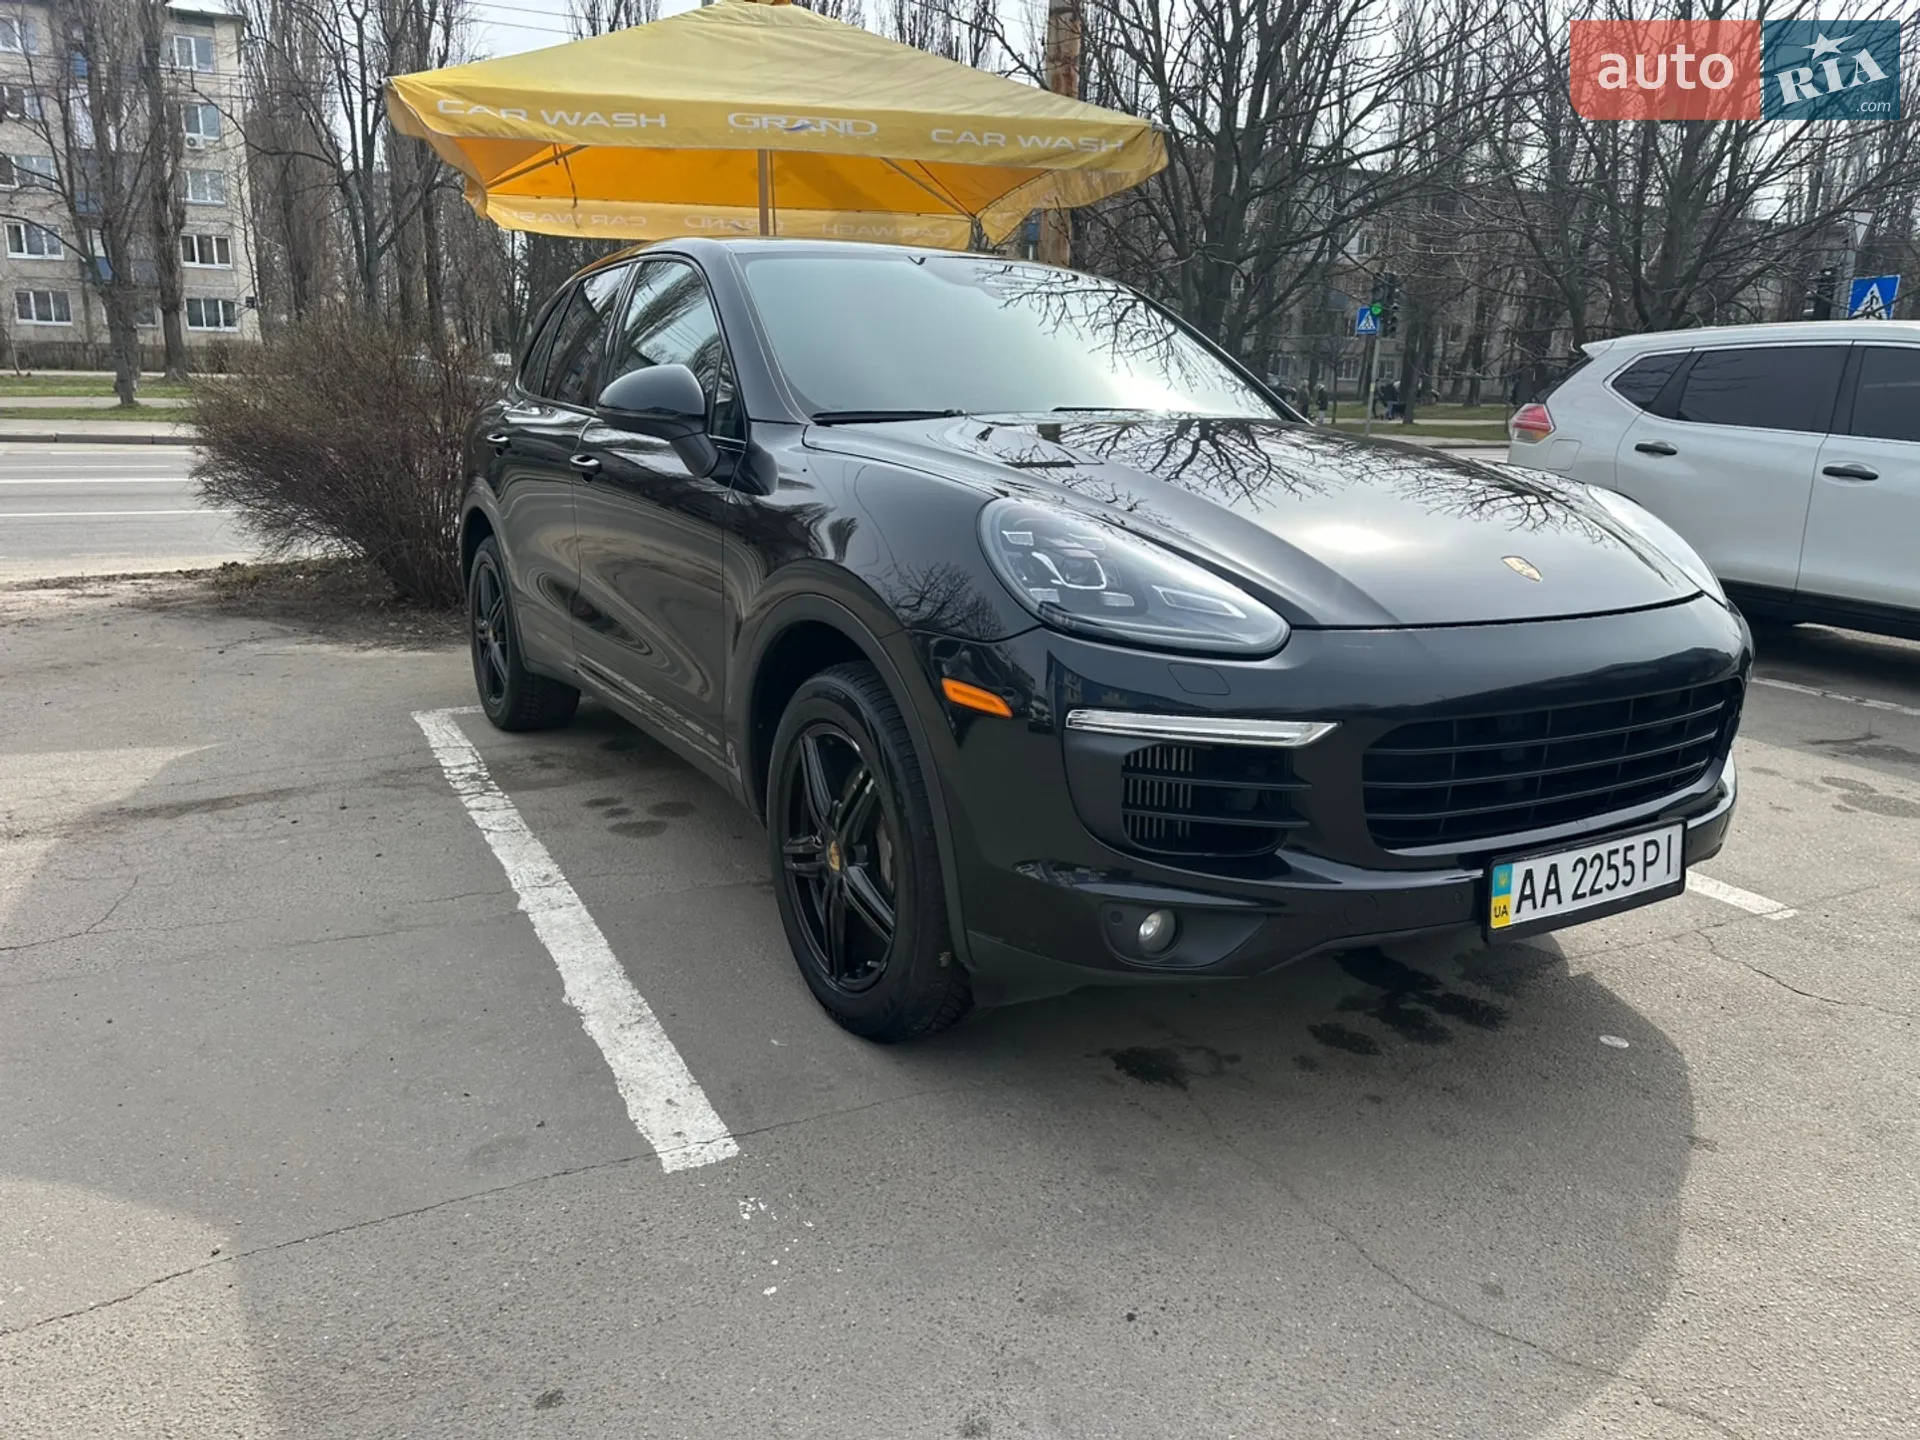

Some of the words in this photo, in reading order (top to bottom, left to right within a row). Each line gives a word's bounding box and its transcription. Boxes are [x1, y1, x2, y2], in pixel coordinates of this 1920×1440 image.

[437, 99, 528, 121] CAR
[540, 109, 666, 128] WASH
[728, 112, 878, 136] GRAND
[931, 129, 1006, 147] CAR
[1017, 135, 1124, 153] WASH
[1515, 863, 1563, 915] AA
[1571, 844, 1635, 902] 2255
[1493, 906, 1509, 919] UA
